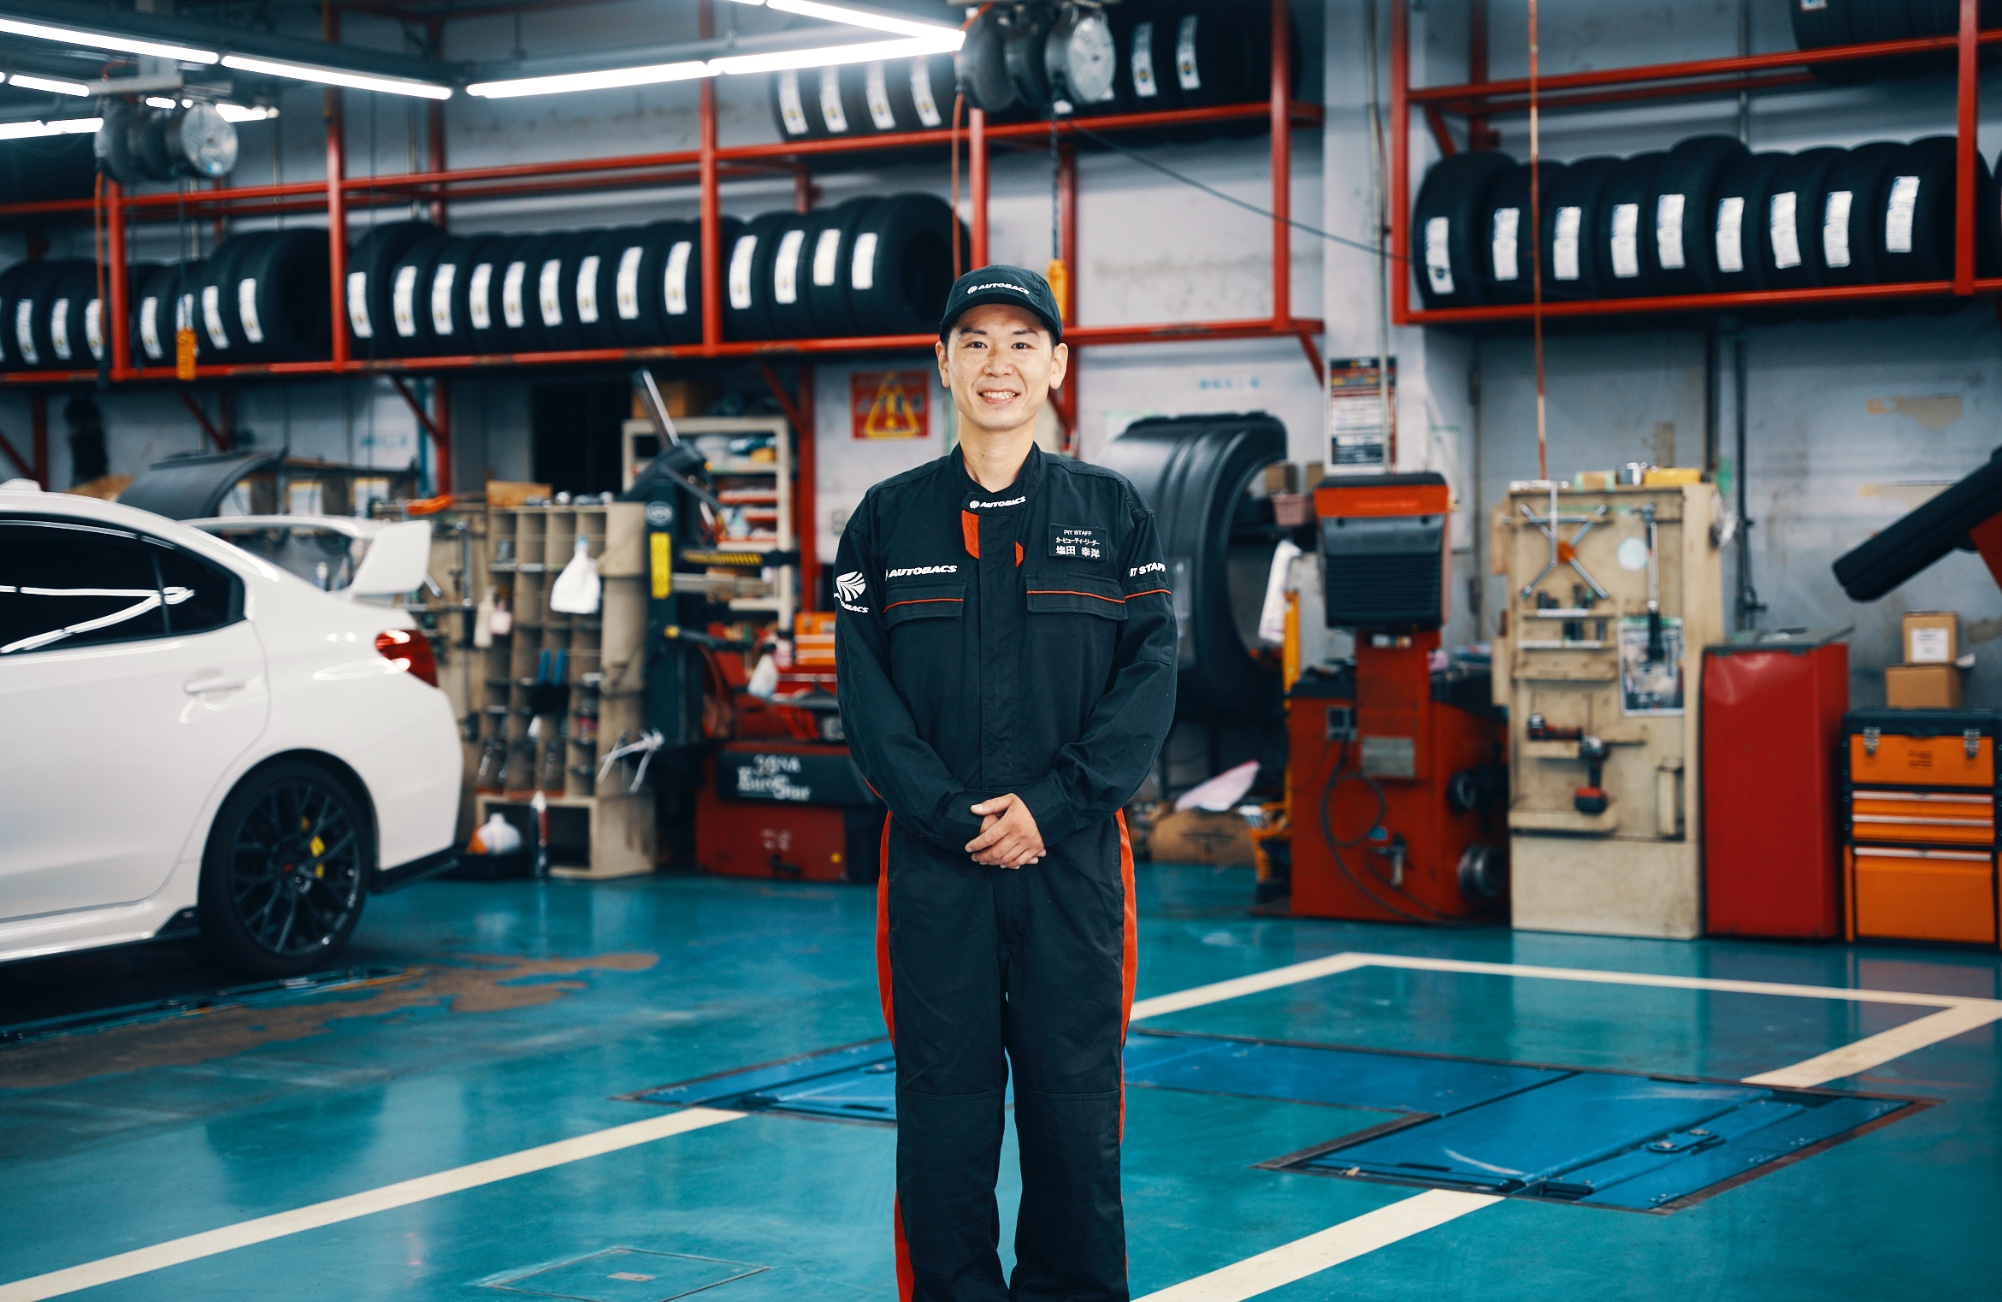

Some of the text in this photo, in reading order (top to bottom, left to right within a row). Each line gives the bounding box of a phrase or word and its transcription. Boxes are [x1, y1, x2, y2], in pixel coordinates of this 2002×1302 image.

[978, 282, 1030, 295] AUTOBACS
[979, 496, 1026, 508] AUTOBACS
[888, 565, 958, 578] AUTOBACS
